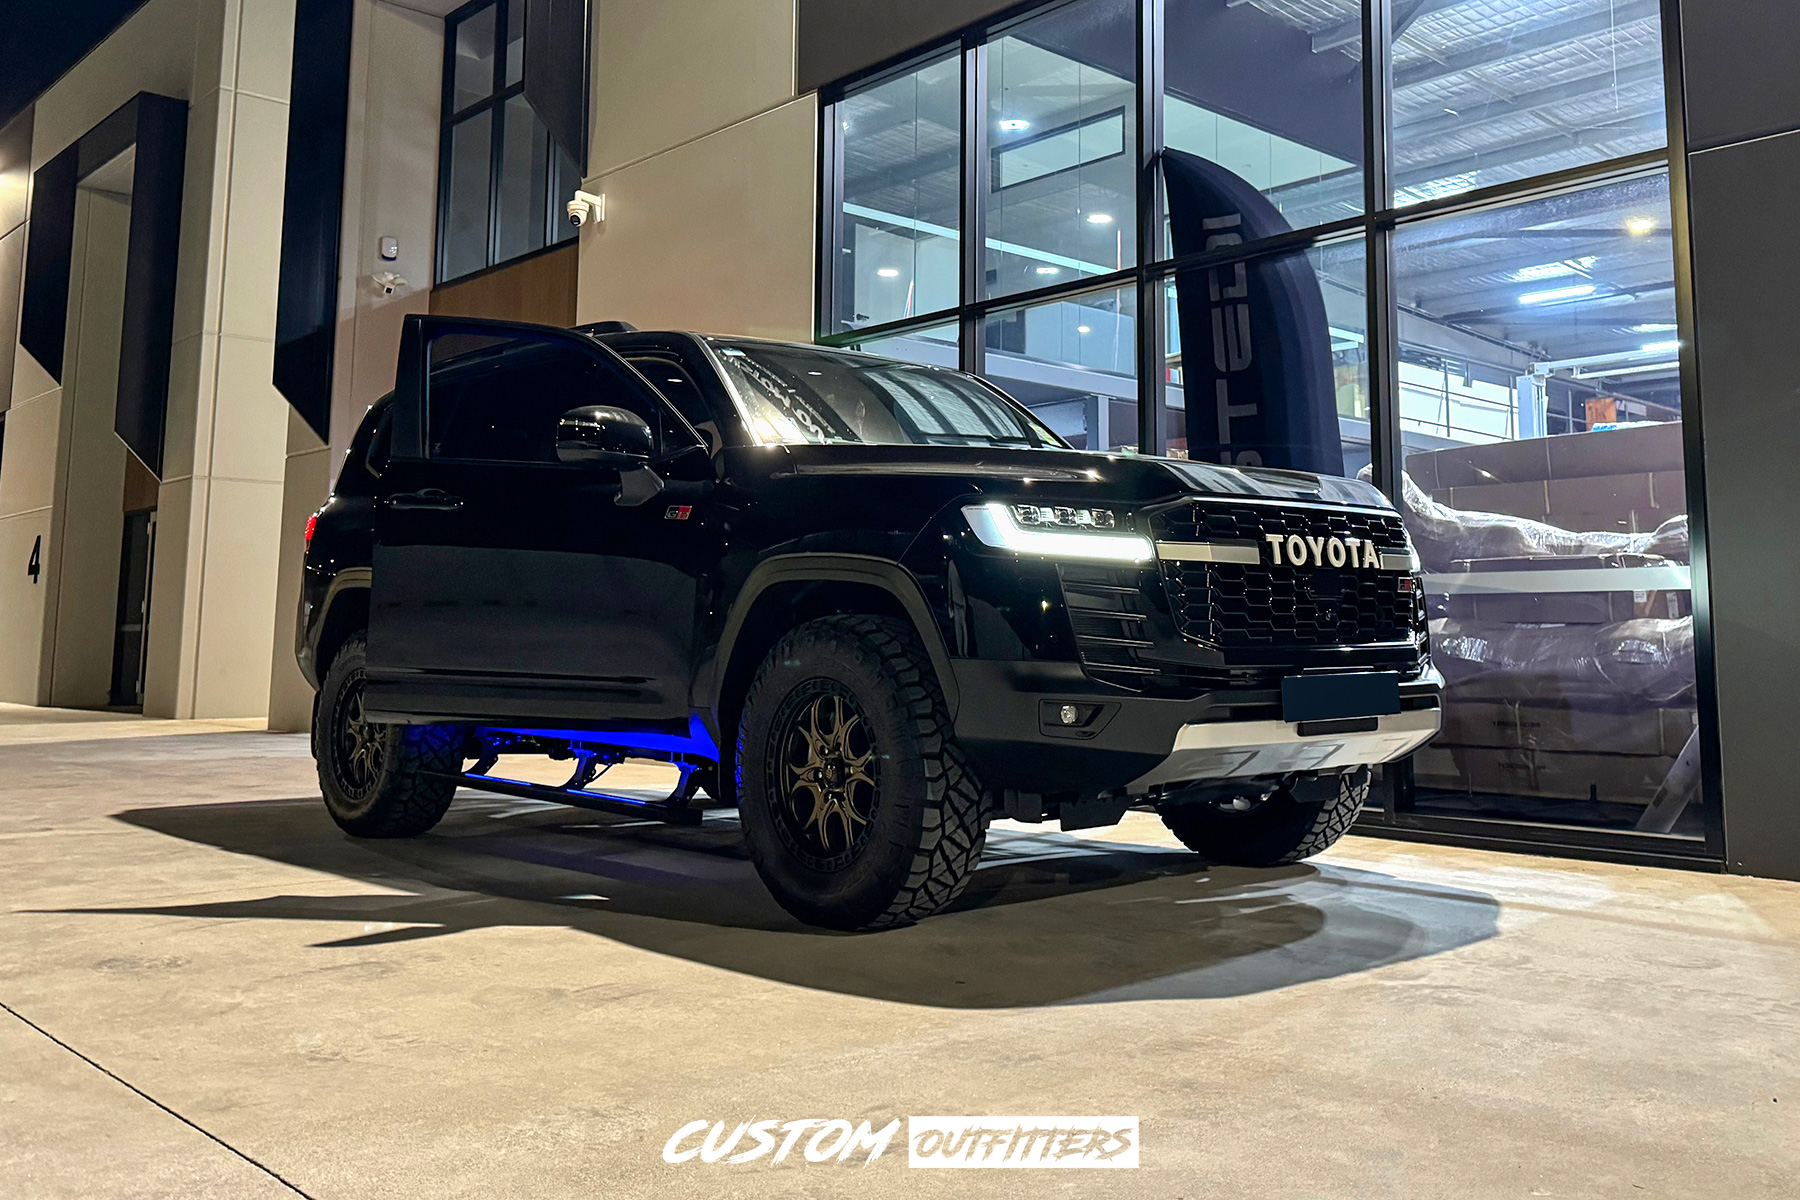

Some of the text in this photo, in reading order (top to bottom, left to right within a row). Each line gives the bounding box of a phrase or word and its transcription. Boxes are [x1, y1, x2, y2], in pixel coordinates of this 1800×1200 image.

[1203, 213, 1263, 467] TEDI
[28, 534, 41, 584] 4
[1265, 533, 1380, 569] TOYOTA
